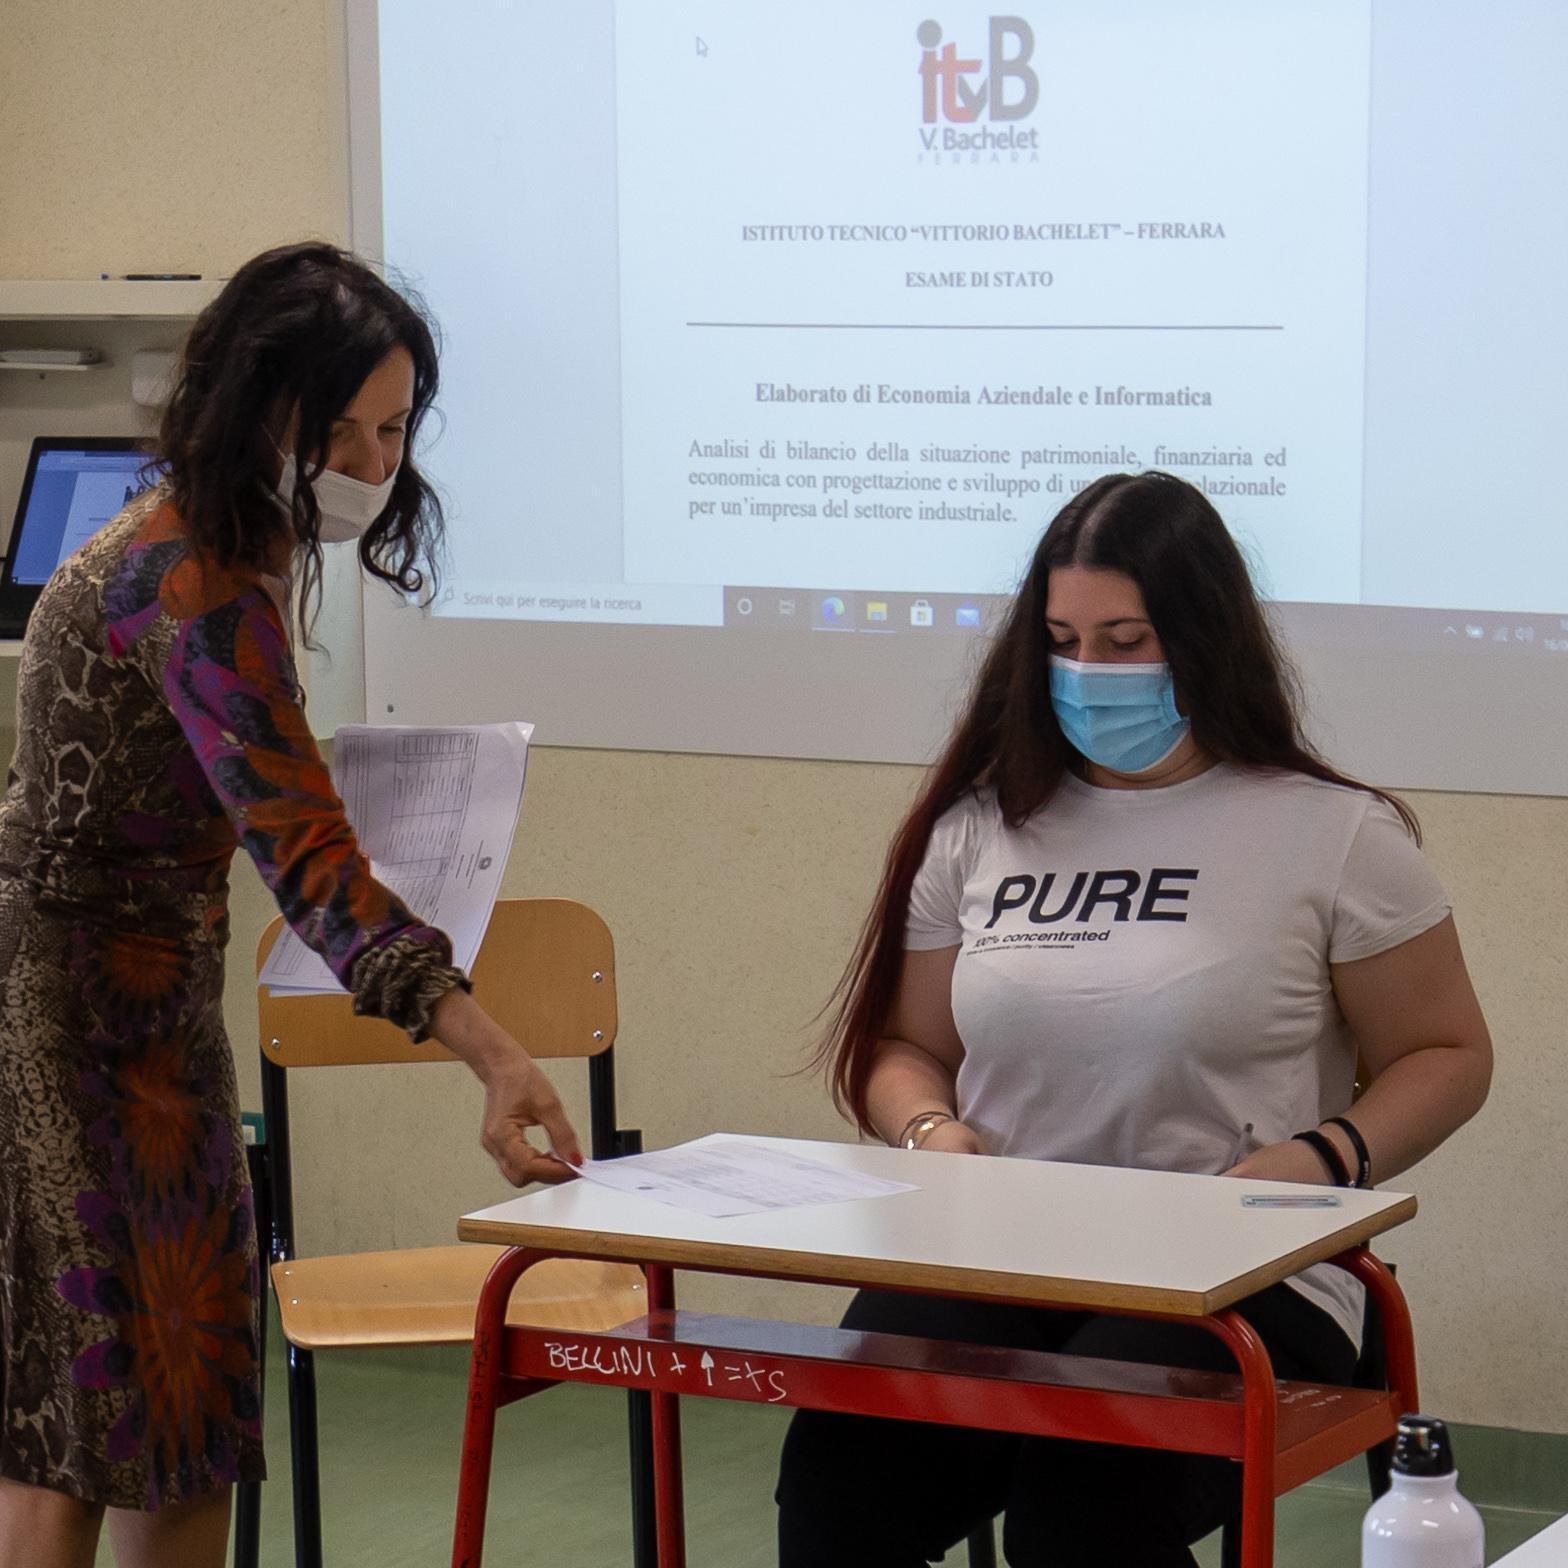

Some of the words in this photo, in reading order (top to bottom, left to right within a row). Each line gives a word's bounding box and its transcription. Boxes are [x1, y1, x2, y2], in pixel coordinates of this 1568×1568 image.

[919, 127, 938, 151] V.
[943, 125, 1039, 151] Bachelet
[743, 225, 824, 241] ISTITUTO
[827, 225, 908, 241] TECNICO
[1138, 222, 1225, 239] FERRARA
[906, 272, 966, 287] ESAME
[971, 271, 989, 287] DI
[993, 271, 1054, 287] STATO
[756, 383, 847, 403] Elaborato
[852, 384, 871, 403] di
[878, 384, 971, 404] Economia
[977, 385, 1072, 405] Aziendale
[1078, 391, 1088, 405] e
[1095, 385, 1212, 406] Informatica
[688, 440, 749, 458] Analisi
[759, 441, 775, 459] di
[786, 441, 857, 460] bilancio
[866, 442, 909, 461] della
[920, 443, 1011, 464] situazione
[1021, 444, 1144, 469] patrimoniale,
[1153, 445, 1253, 466] finanziaria
[1264, 447, 1287, 467] ed
[688, 468, 781, 487] economica
[785, 474, 817, 488] con
[823, 471, 942, 494] progettazione
[947, 478, 957, 491] e
[963, 472, 1041, 498] sviluppo
[1045, 473, 1063, 493] di
[688, 501, 717, 519] per
[822, 498, 848, 519] del
[854, 504, 912, 519] settore
[919, 501, 1017, 522] industriale.
[496, 594, 514, 608] qui
[517, 598, 536, 609] per
[590, 596, 600, 609] la
[604, 598, 642, 610] ricerca
[984, 868, 1199, 928] PURE
[1003, 930, 1111, 942] concentrated
[544, 1342, 656, 1377] BELLINI
